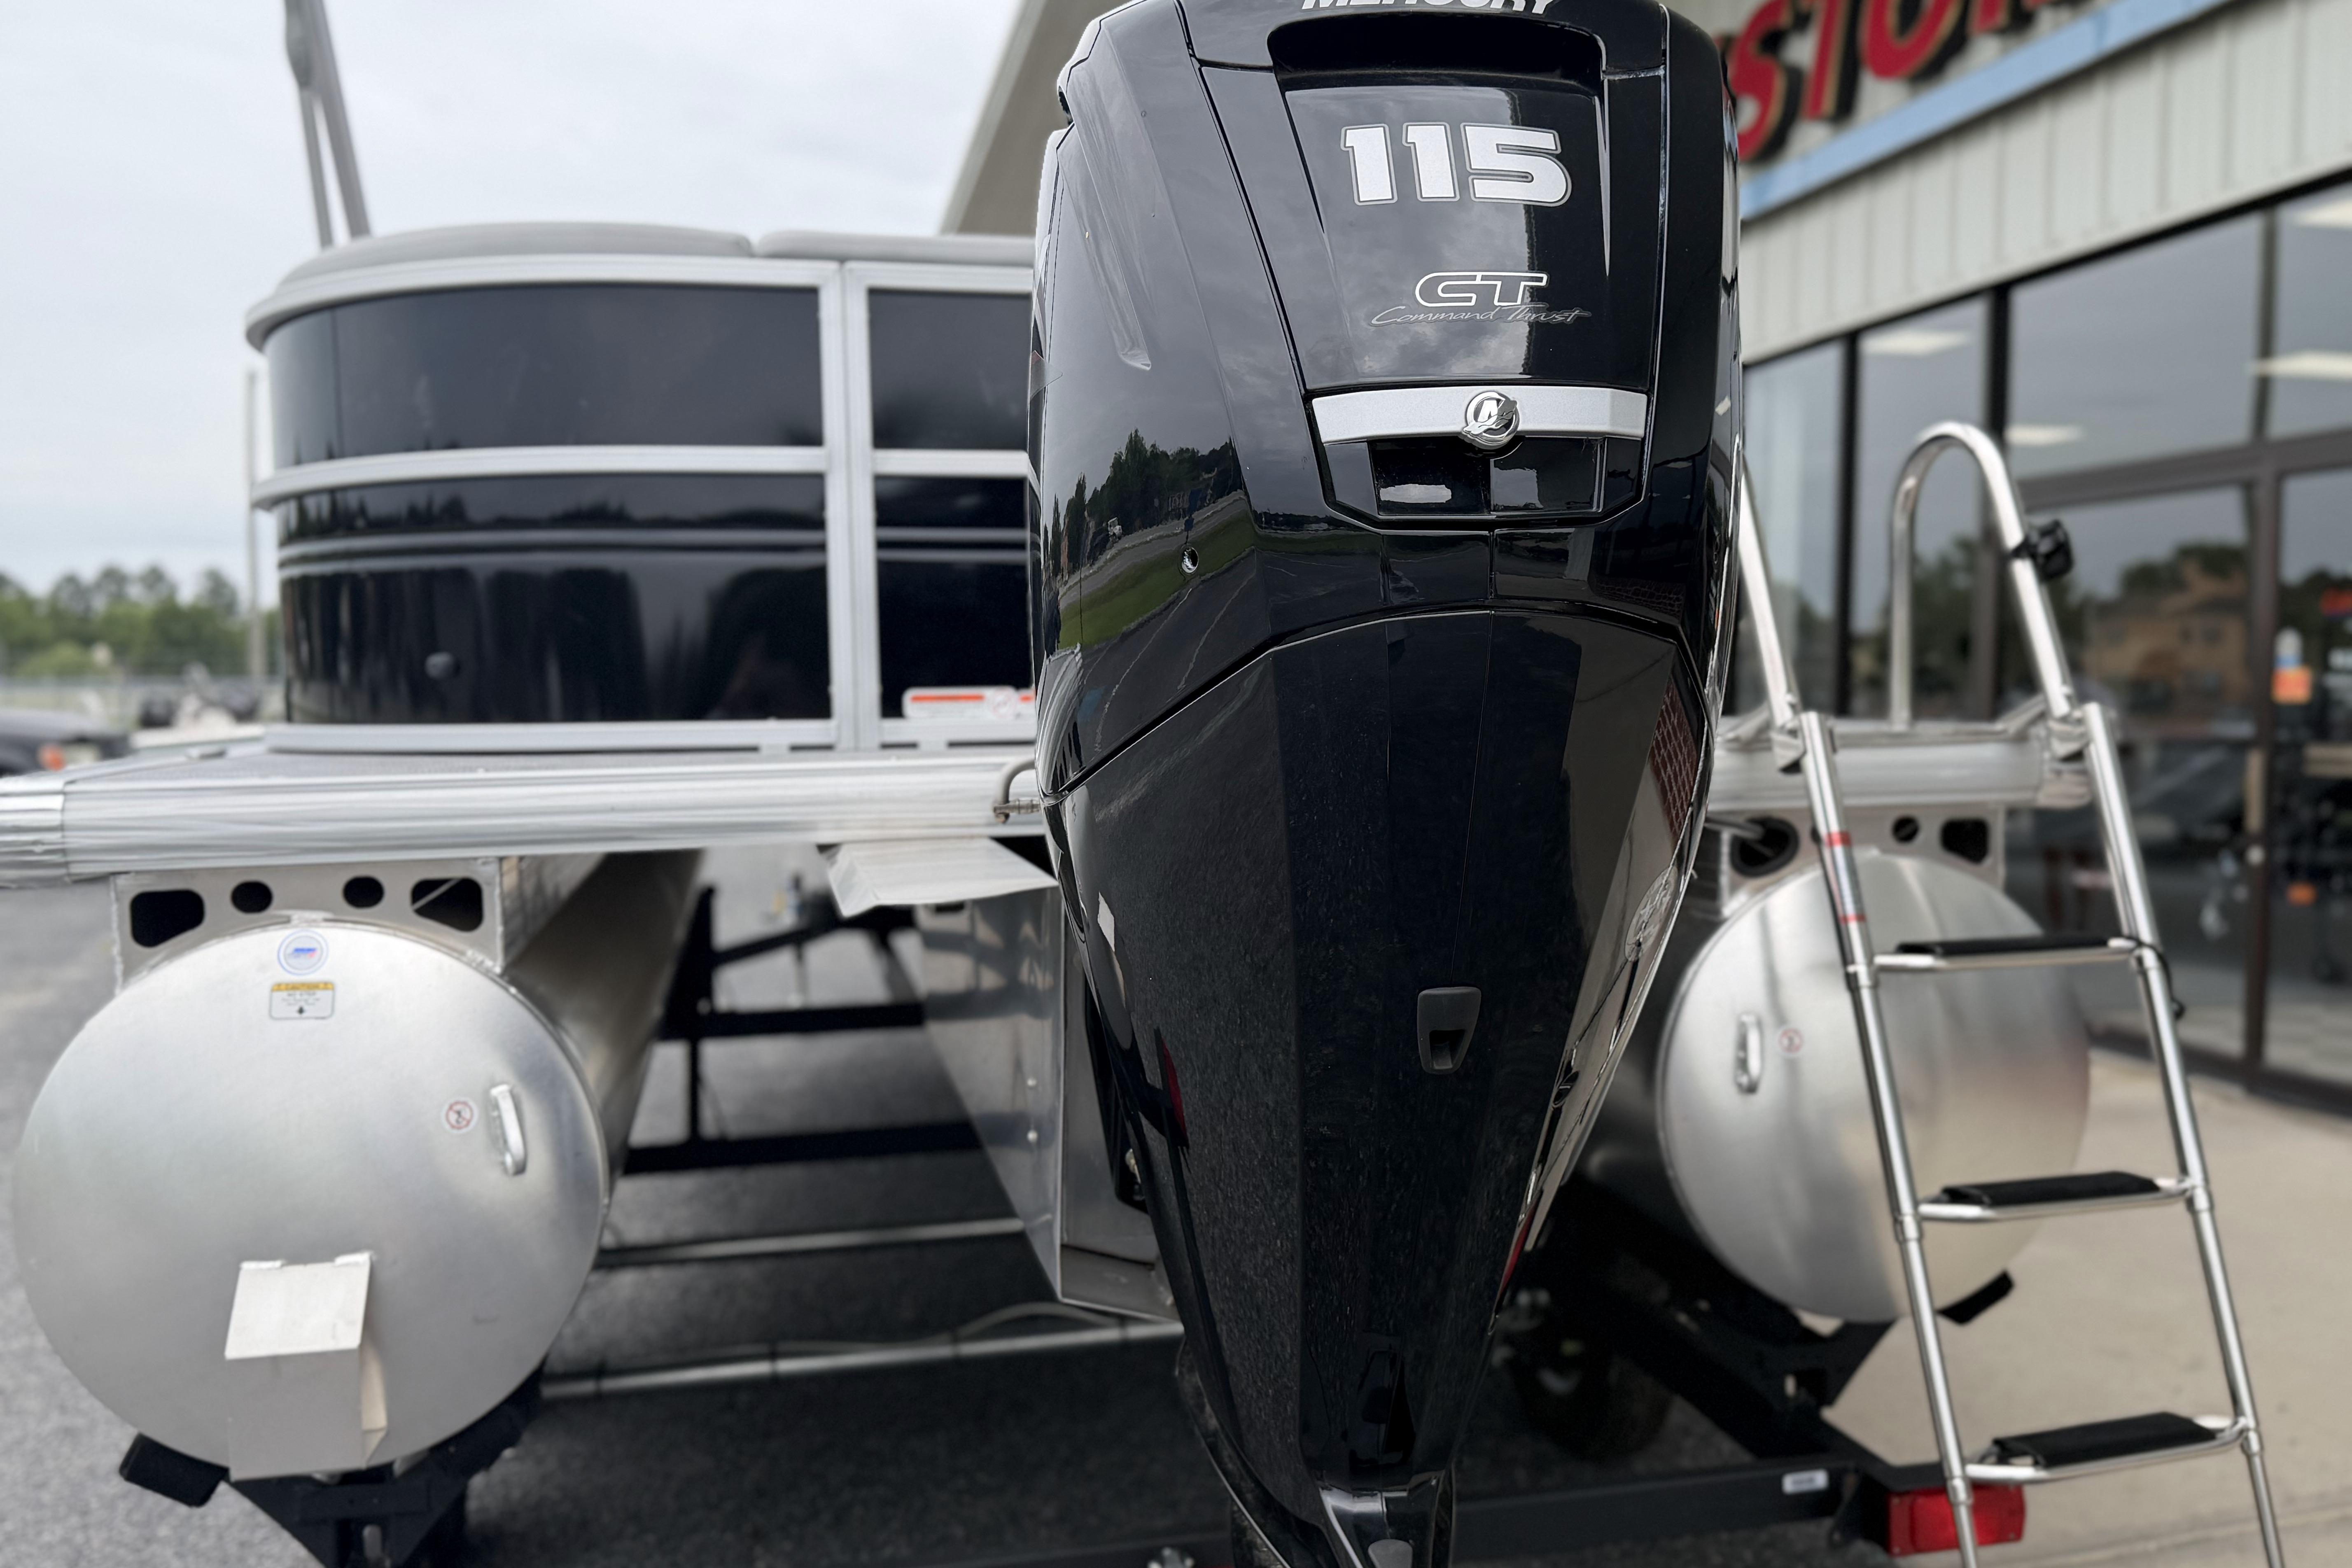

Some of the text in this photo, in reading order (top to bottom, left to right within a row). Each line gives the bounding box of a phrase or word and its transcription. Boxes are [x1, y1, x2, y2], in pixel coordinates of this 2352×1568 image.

[1341, 122, 1572, 206] 115
[1370, 304, 1592, 325] Command Thrust
